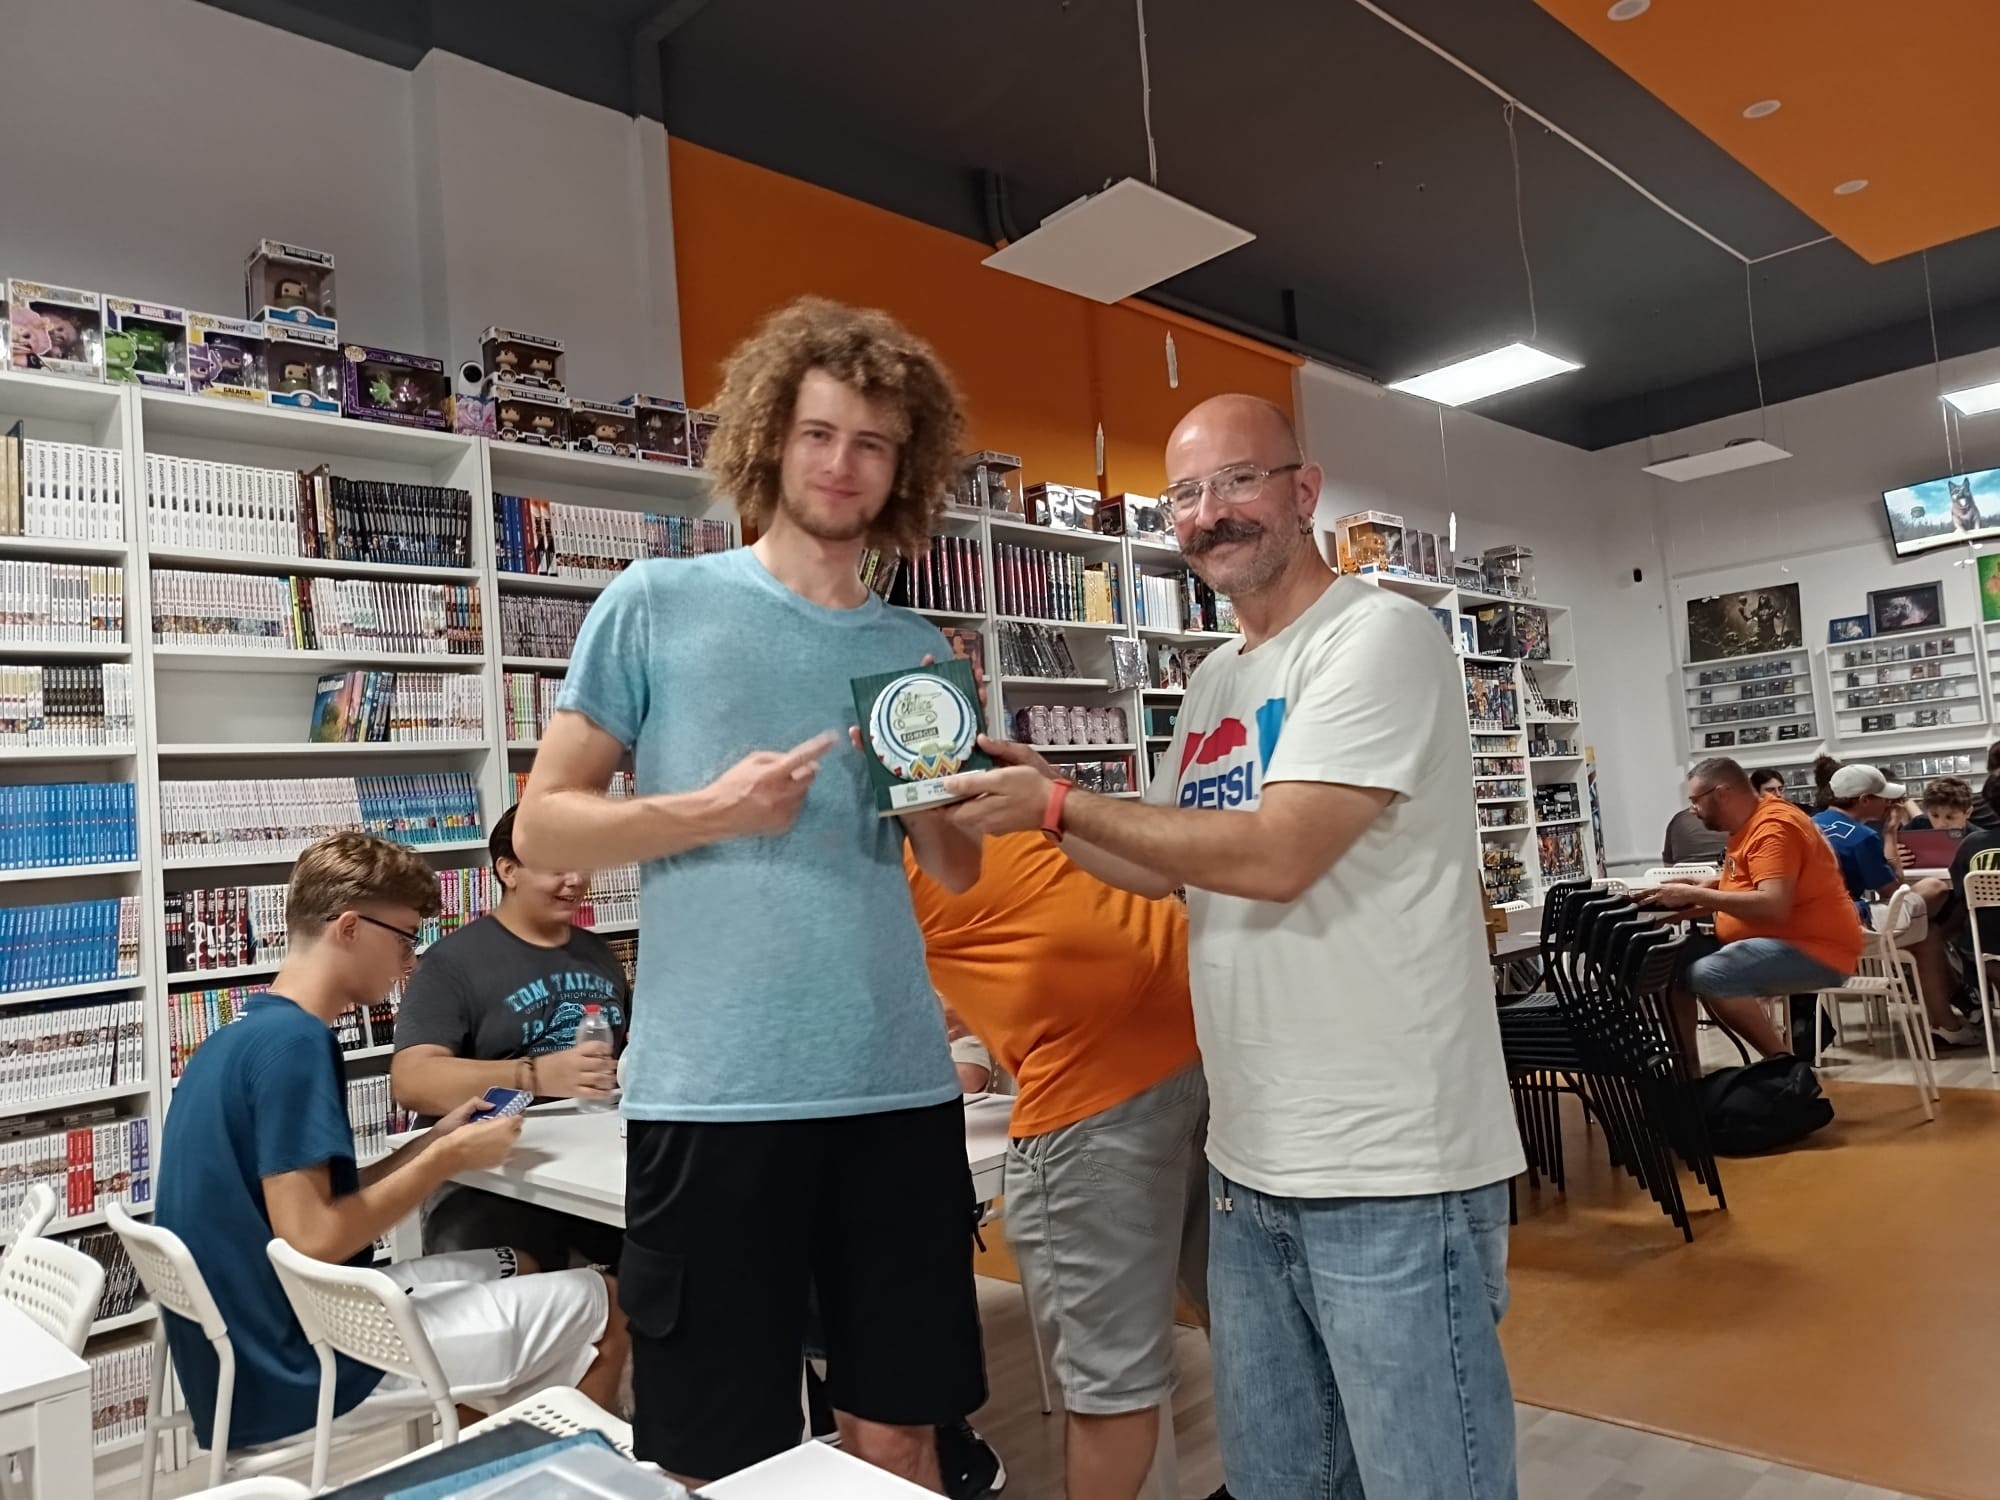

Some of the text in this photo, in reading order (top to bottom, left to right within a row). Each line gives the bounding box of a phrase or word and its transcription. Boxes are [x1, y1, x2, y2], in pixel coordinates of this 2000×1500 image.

[1180, 761, 1254, 810] PEPSI
[504, 978, 550, 1012] TOM
[550, 972, 615, 997] TAILOR
